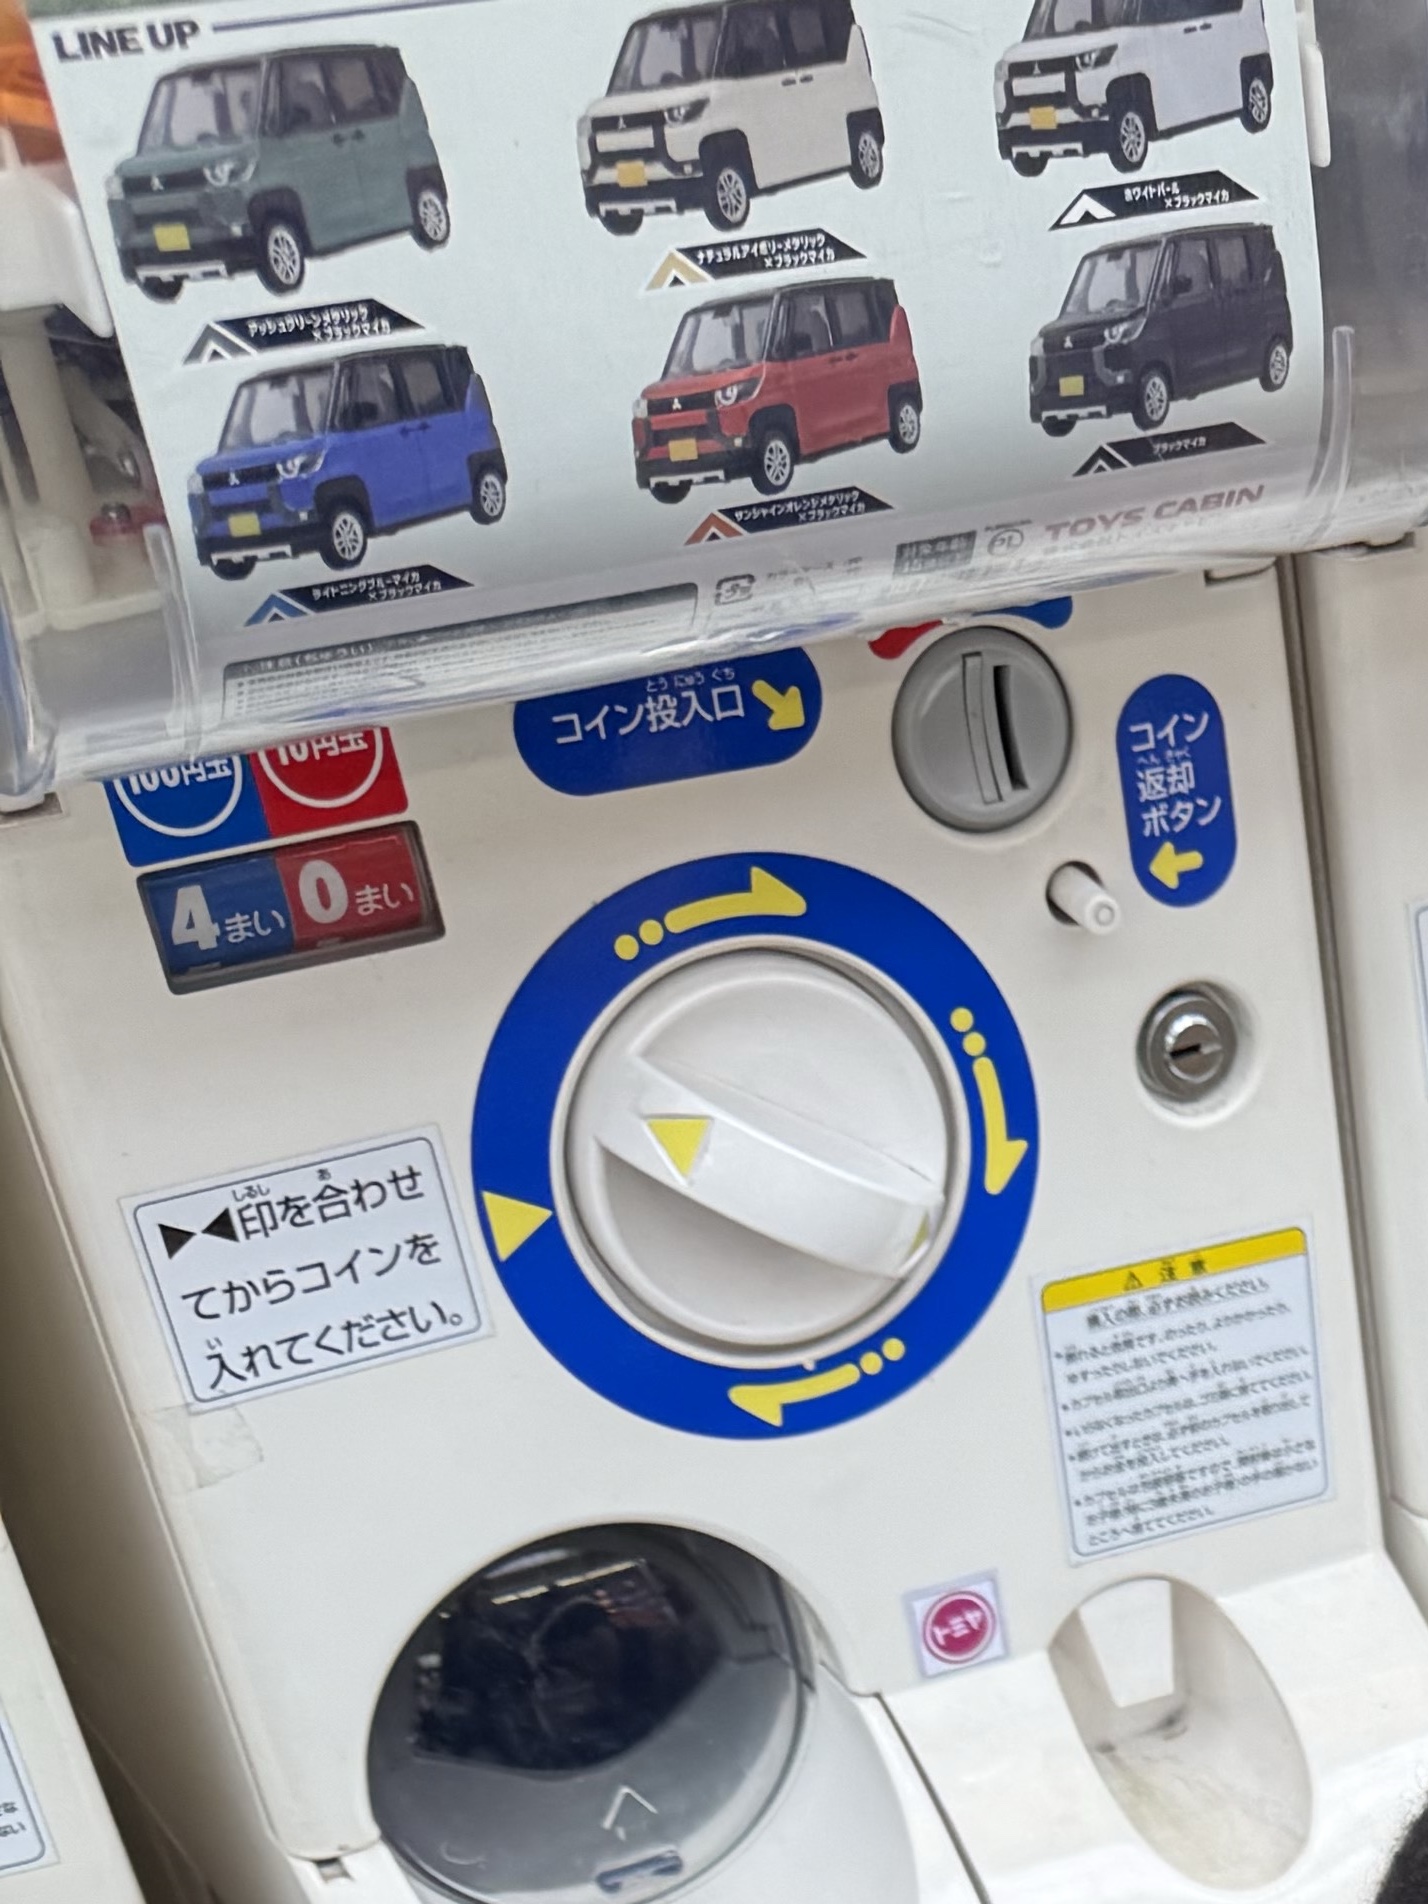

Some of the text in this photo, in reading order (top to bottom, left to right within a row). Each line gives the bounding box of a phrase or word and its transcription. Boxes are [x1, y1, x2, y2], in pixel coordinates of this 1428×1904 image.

[52, 20, 200, 63] LINE UP
[1044, 506, 1144, 541] TOYS
[1152, 485, 1265, 520] CABIN
[551, 684, 745, 745] コイン投入口
[1129, 710, 1210, 753] コイン
[1136, 760, 1196, 803] 返却
[1141, 795, 1222, 838] ボタン
[181, 1233, 442, 1321] てからコインを
[206, 1300, 464, 1390] 入れてください。
